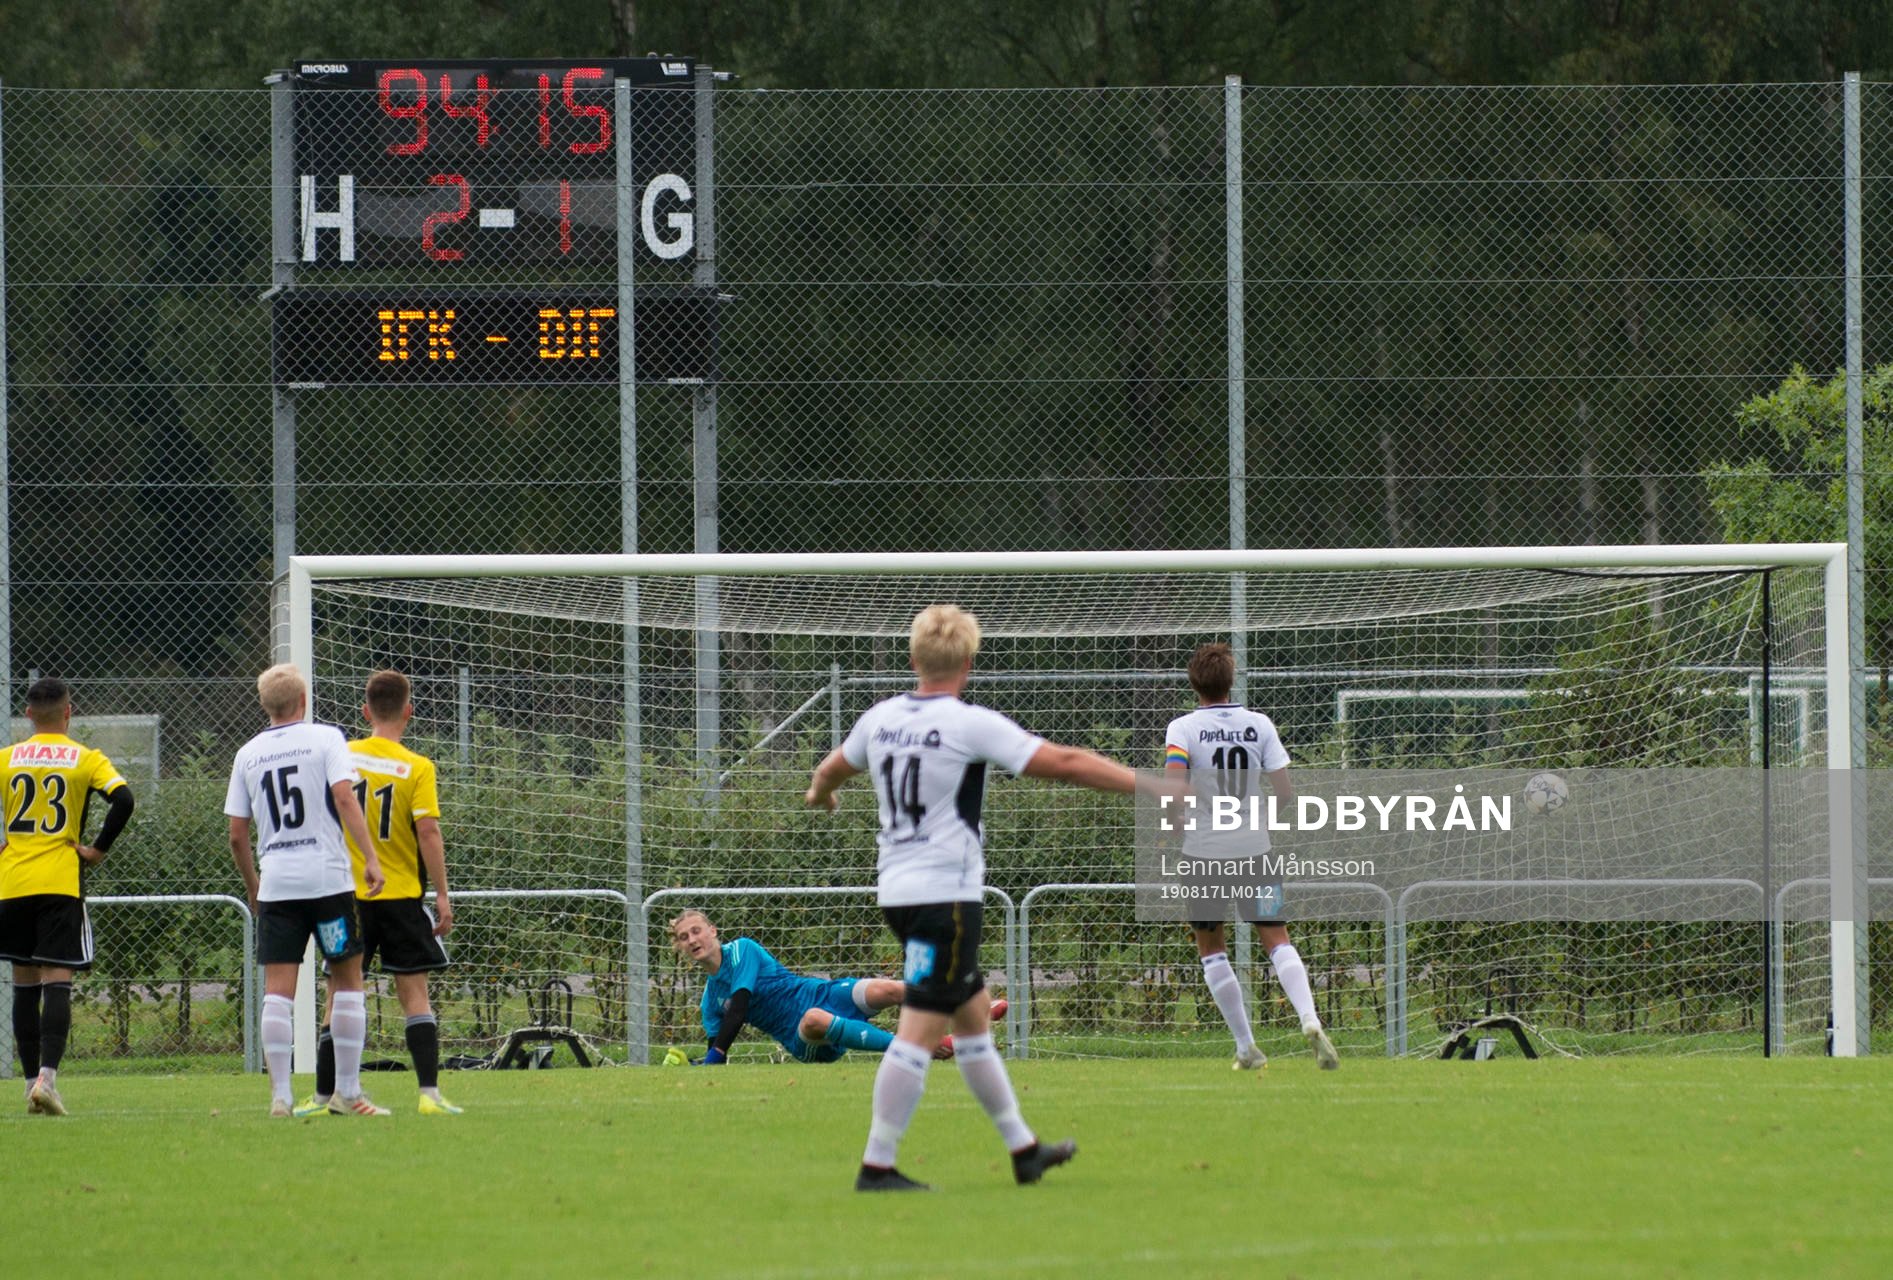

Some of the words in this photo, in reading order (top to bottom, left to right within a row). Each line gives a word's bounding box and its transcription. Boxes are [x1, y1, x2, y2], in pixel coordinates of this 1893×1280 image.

[301, 175, 354, 262] H
[421, 174, 471, 261] 2
[559, 179, 572, 255] 1
[641, 173, 694, 260] G
[13, 744, 78, 762] MAXI
[258, 748, 312, 765] Automotive
[1212, 745, 1249, 801] 10
[8, 772, 68, 835] 23
[260, 764, 306, 834] 15
[881, 754, 926, 830] 14
